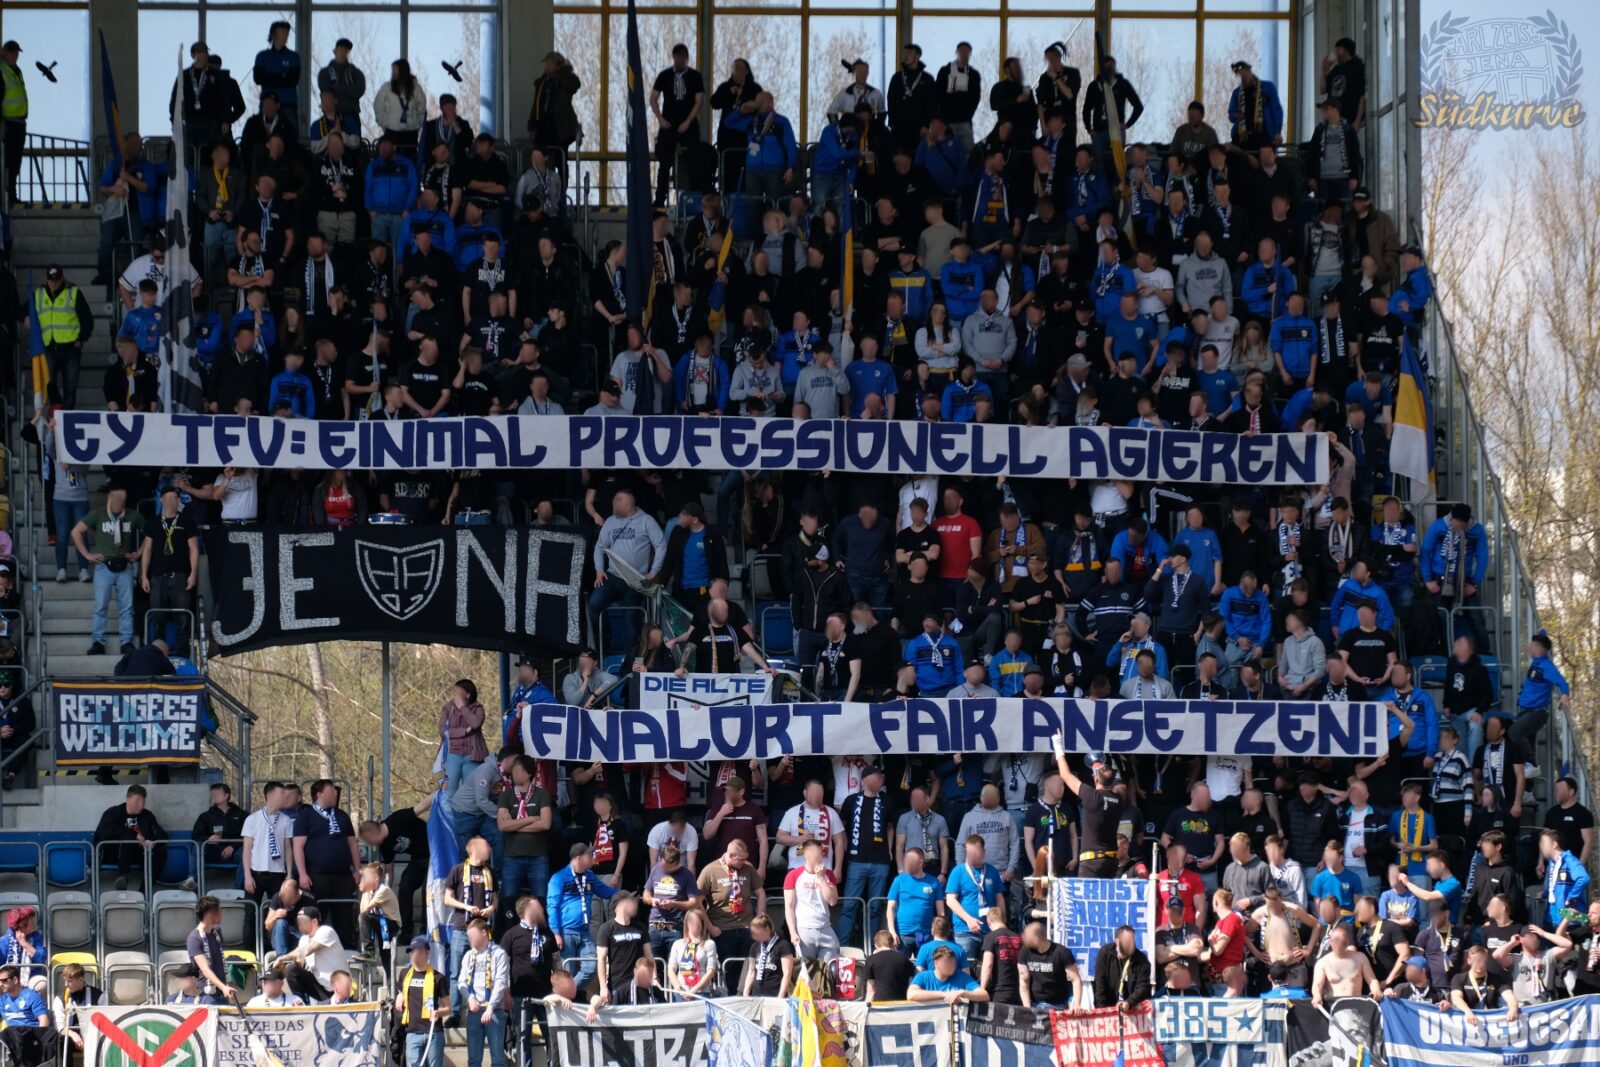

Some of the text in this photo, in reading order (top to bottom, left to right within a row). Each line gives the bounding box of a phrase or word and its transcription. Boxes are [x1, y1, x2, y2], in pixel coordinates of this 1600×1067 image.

[63, 412, 1317, 485] EY TFV: EINMAL PROFESSIONELL AGIEREN
[644, 676, 766, 694] DIE ALTE
[60, 694, 198, 722] REFUGEES
[60, 722, 195, 753] WELCOME
[530, 699, 1377, 762] FINALORT FAIR ANSETZEN!
[1068, 878, 1149, 901] ERNST
[1066, 928, 1148, 952] SPOT
[275, 1020, 305, 1031] DAS
[1157, 1001, 1229, 1038] 385
[219, 1051, 235, 1061] ES
[1503, 1054, 1529, 1066] UND
